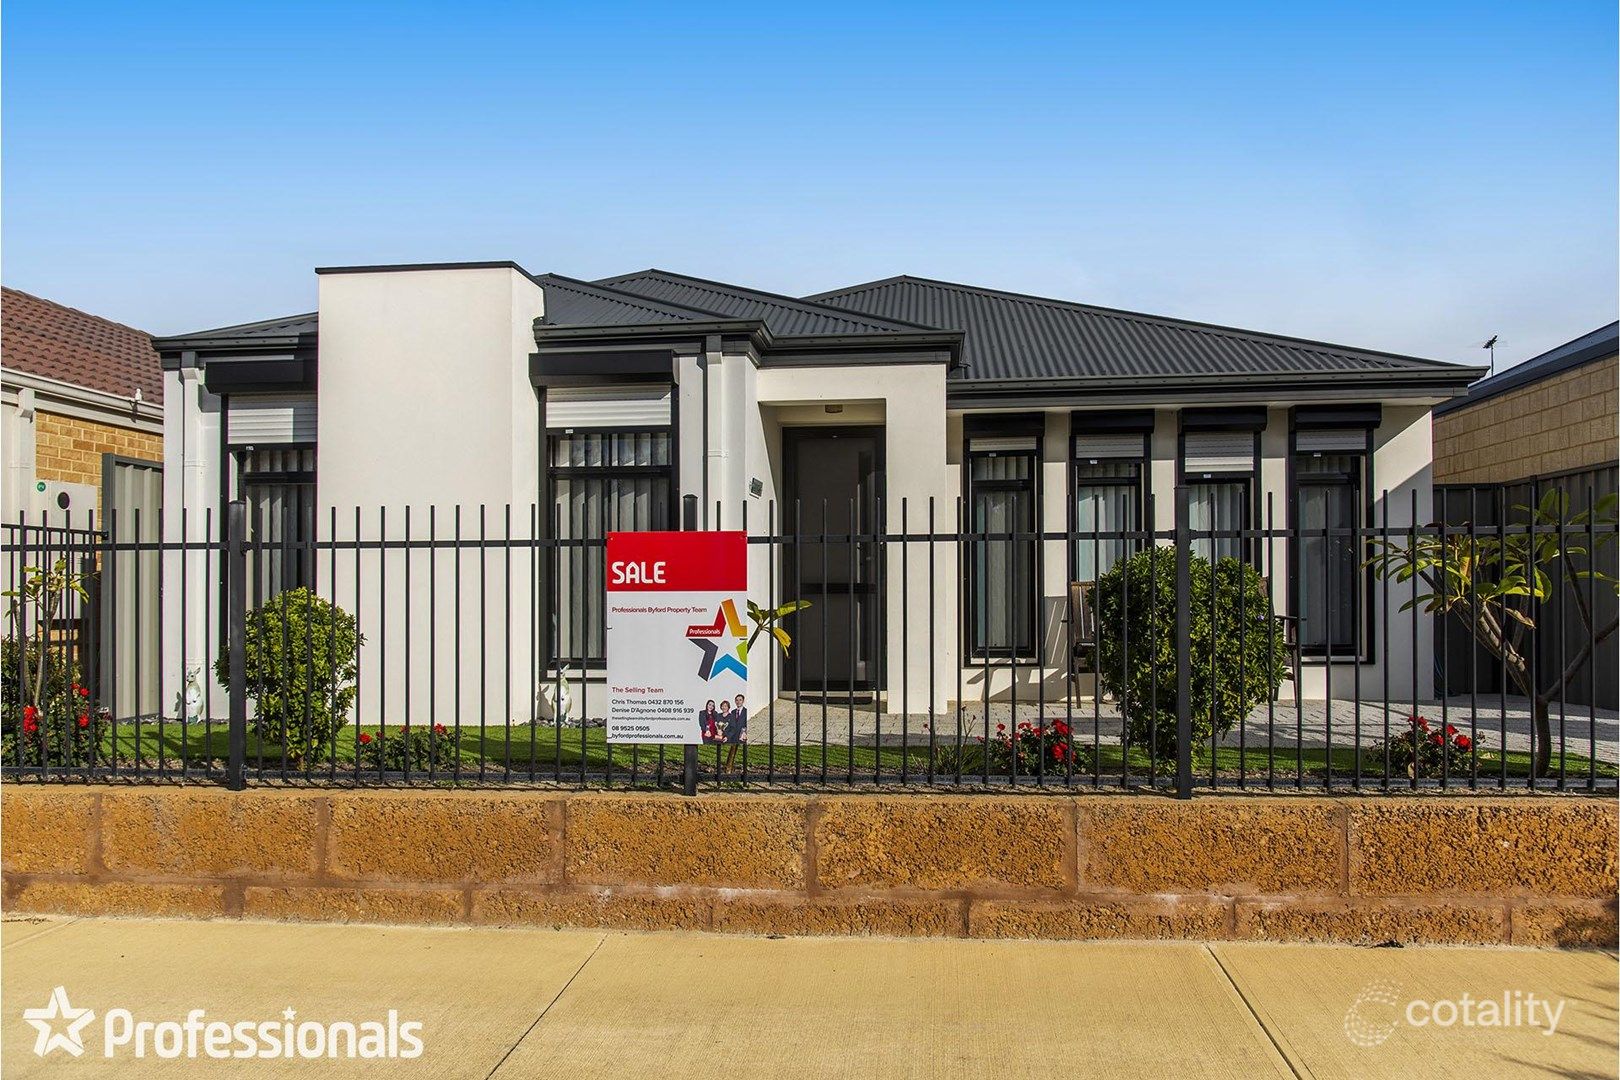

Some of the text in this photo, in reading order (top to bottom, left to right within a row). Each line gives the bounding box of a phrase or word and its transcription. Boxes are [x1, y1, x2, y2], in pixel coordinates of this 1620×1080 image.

[611, 561, 667, 584] SALE
[648, 606, 666, 614] Byford
[667, 606, 691, 614] Property
[624, 686, 646, 694] Selling
